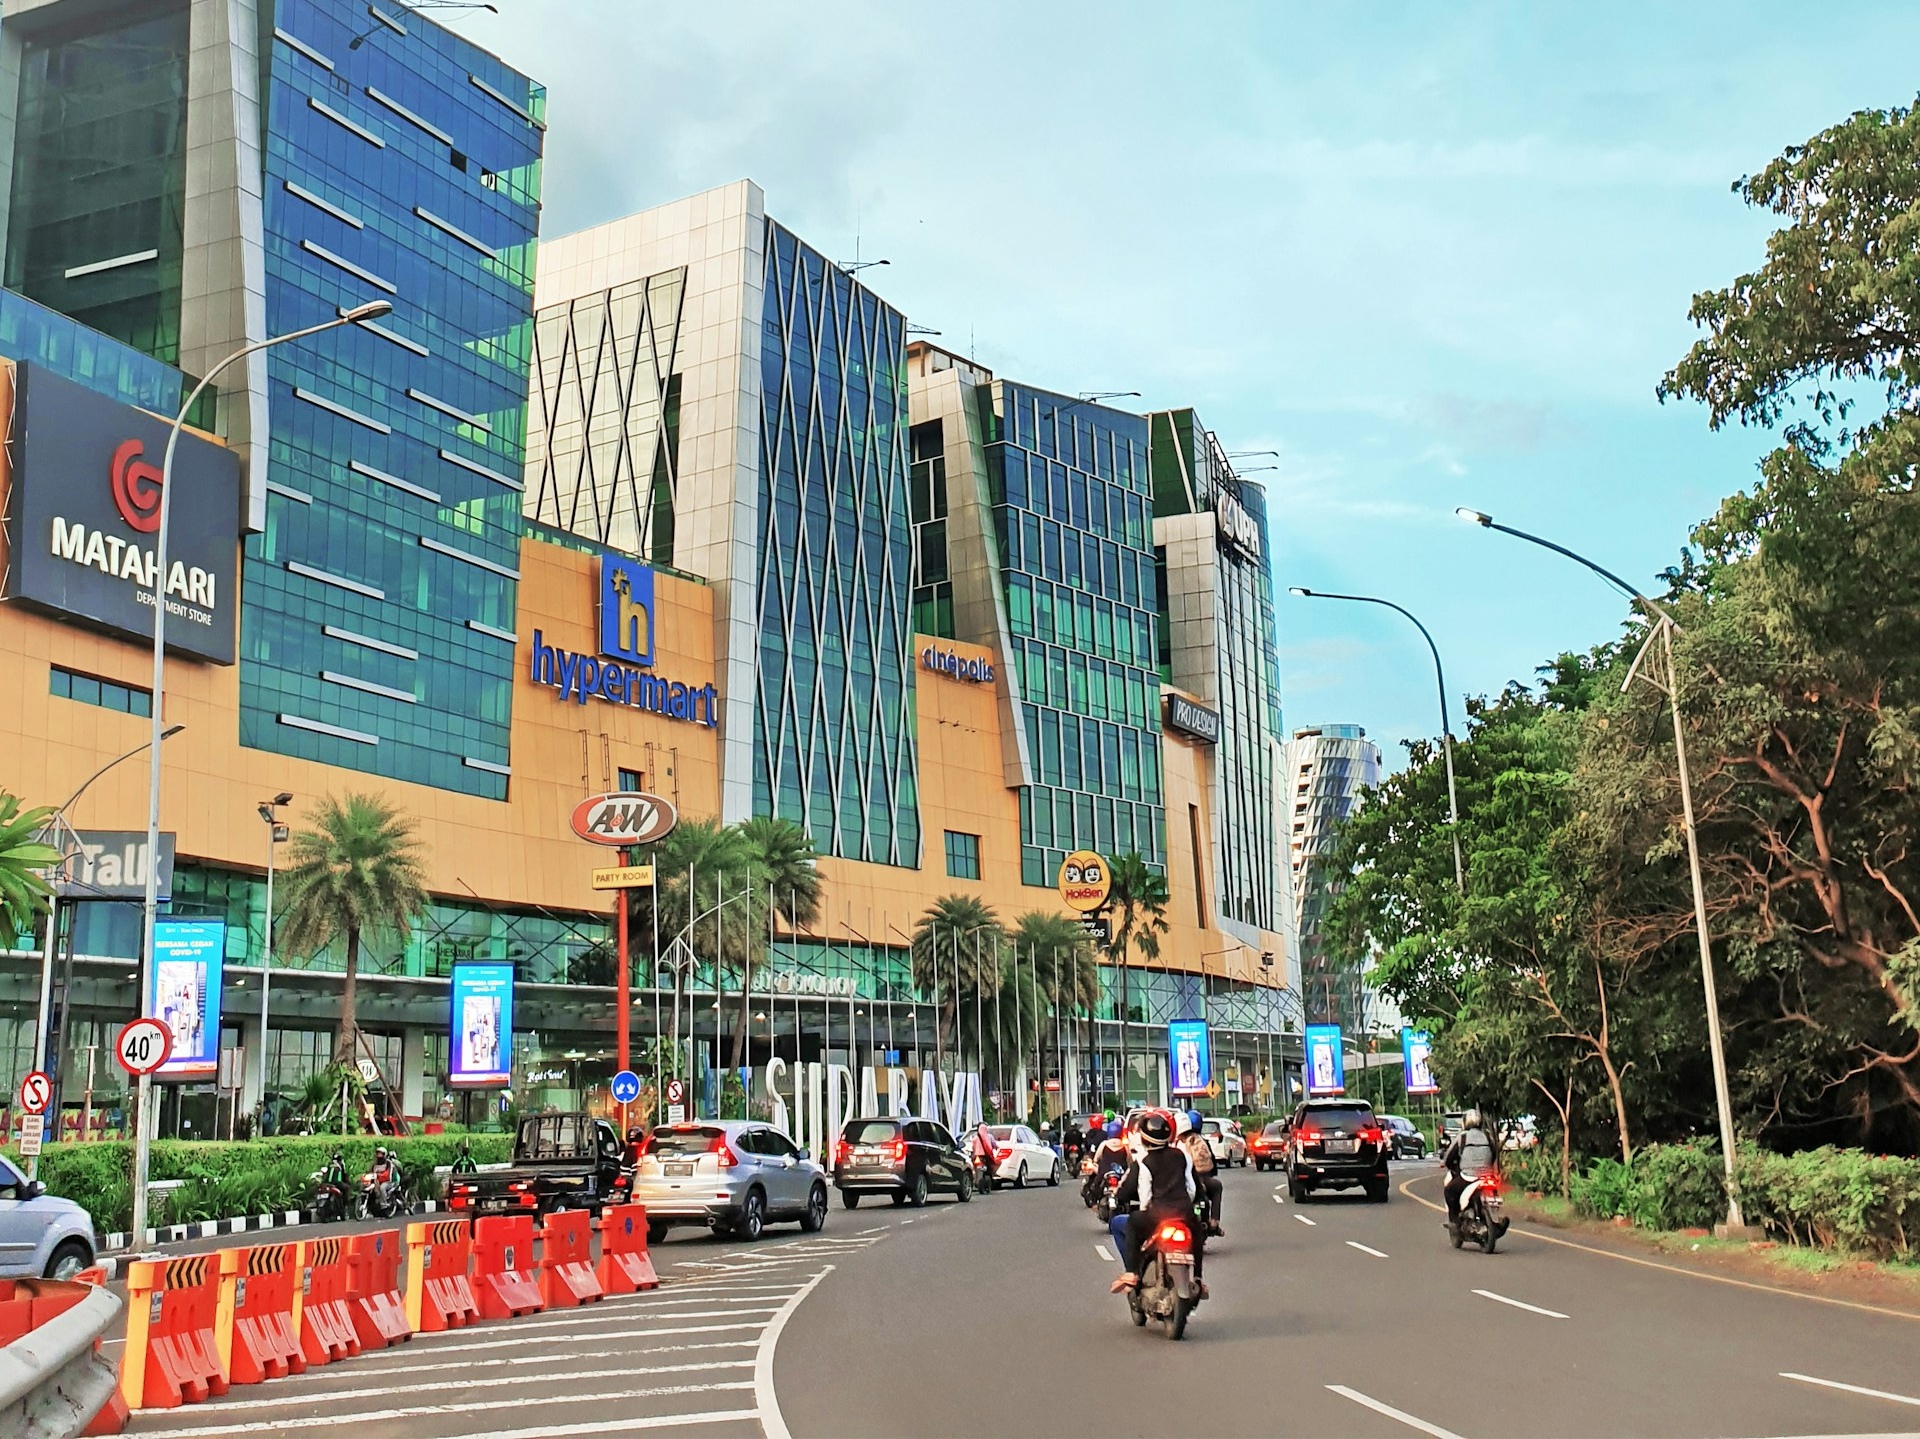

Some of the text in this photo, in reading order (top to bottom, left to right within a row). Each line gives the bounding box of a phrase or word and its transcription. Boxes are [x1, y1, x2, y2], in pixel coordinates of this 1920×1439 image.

[51, 515, 216, 610] MATAHARI
[136, 590, 212, 626] DEPAMENT STORE
[531, 628, 718, 728] hypermart
[922, 643, 995, 683] cinépolis
[1176, 700, 1217, 736] PRO DESIGN
[587, 803, 659, 833] A&W
[595, 871, 649, 883] PARTY ROOM
[1065, 887, 1103, 899] HokBen
[125, 1031, 161, 1062] 40 km
